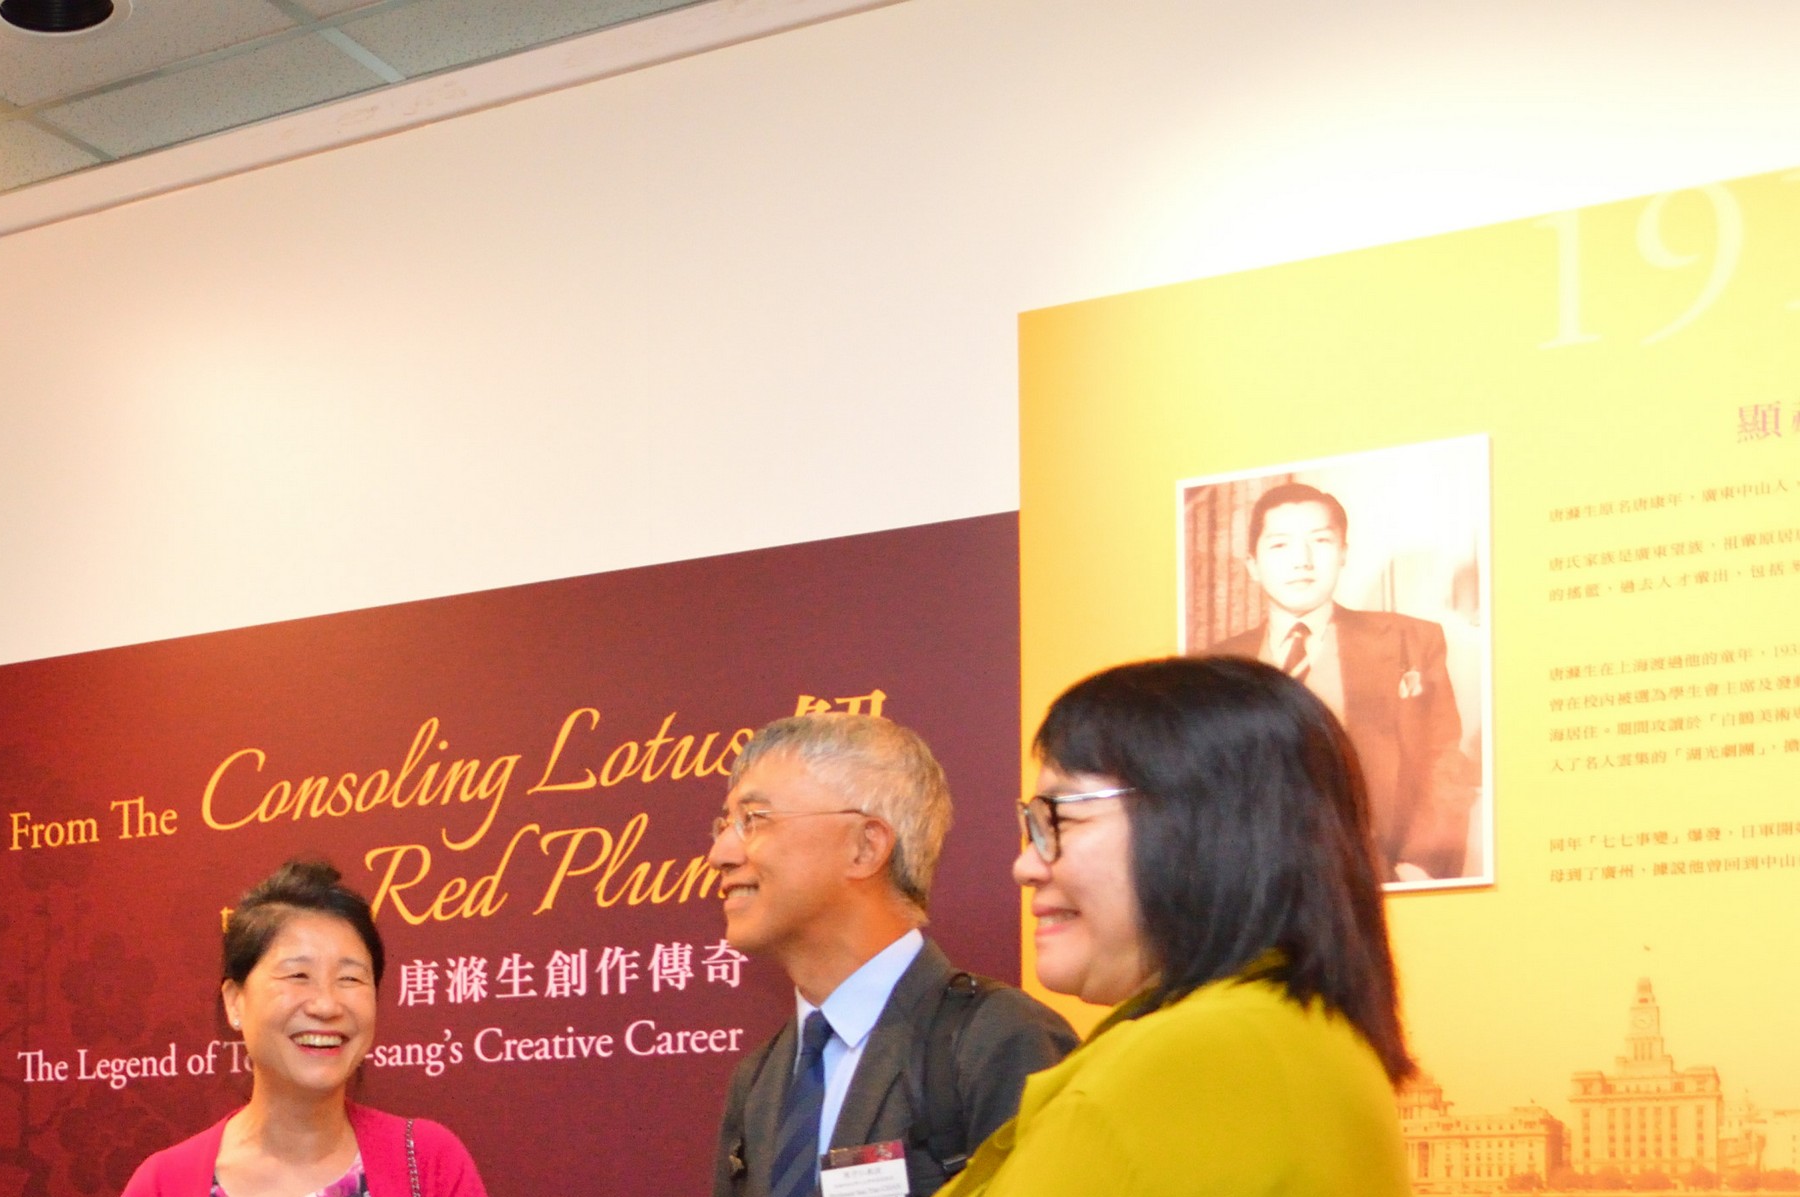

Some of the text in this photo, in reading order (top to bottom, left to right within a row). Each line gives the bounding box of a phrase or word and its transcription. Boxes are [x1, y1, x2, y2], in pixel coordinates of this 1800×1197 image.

[1533, 172, 1800, 348] 19
[9, 707, 753, 851] From The Consoling Lotus
[365, 823, 540, 925] Red
[397, 939, 749, 1007] 唐滌生創作傳奇
[17, 1049, 68, 1083] The
[77, 1043, 179, 1090] Legend
[186, 1040, 221, 1076] of
[473, 1026, 614, 1063] Creative
[624, 1019, 744, 1058] Career
